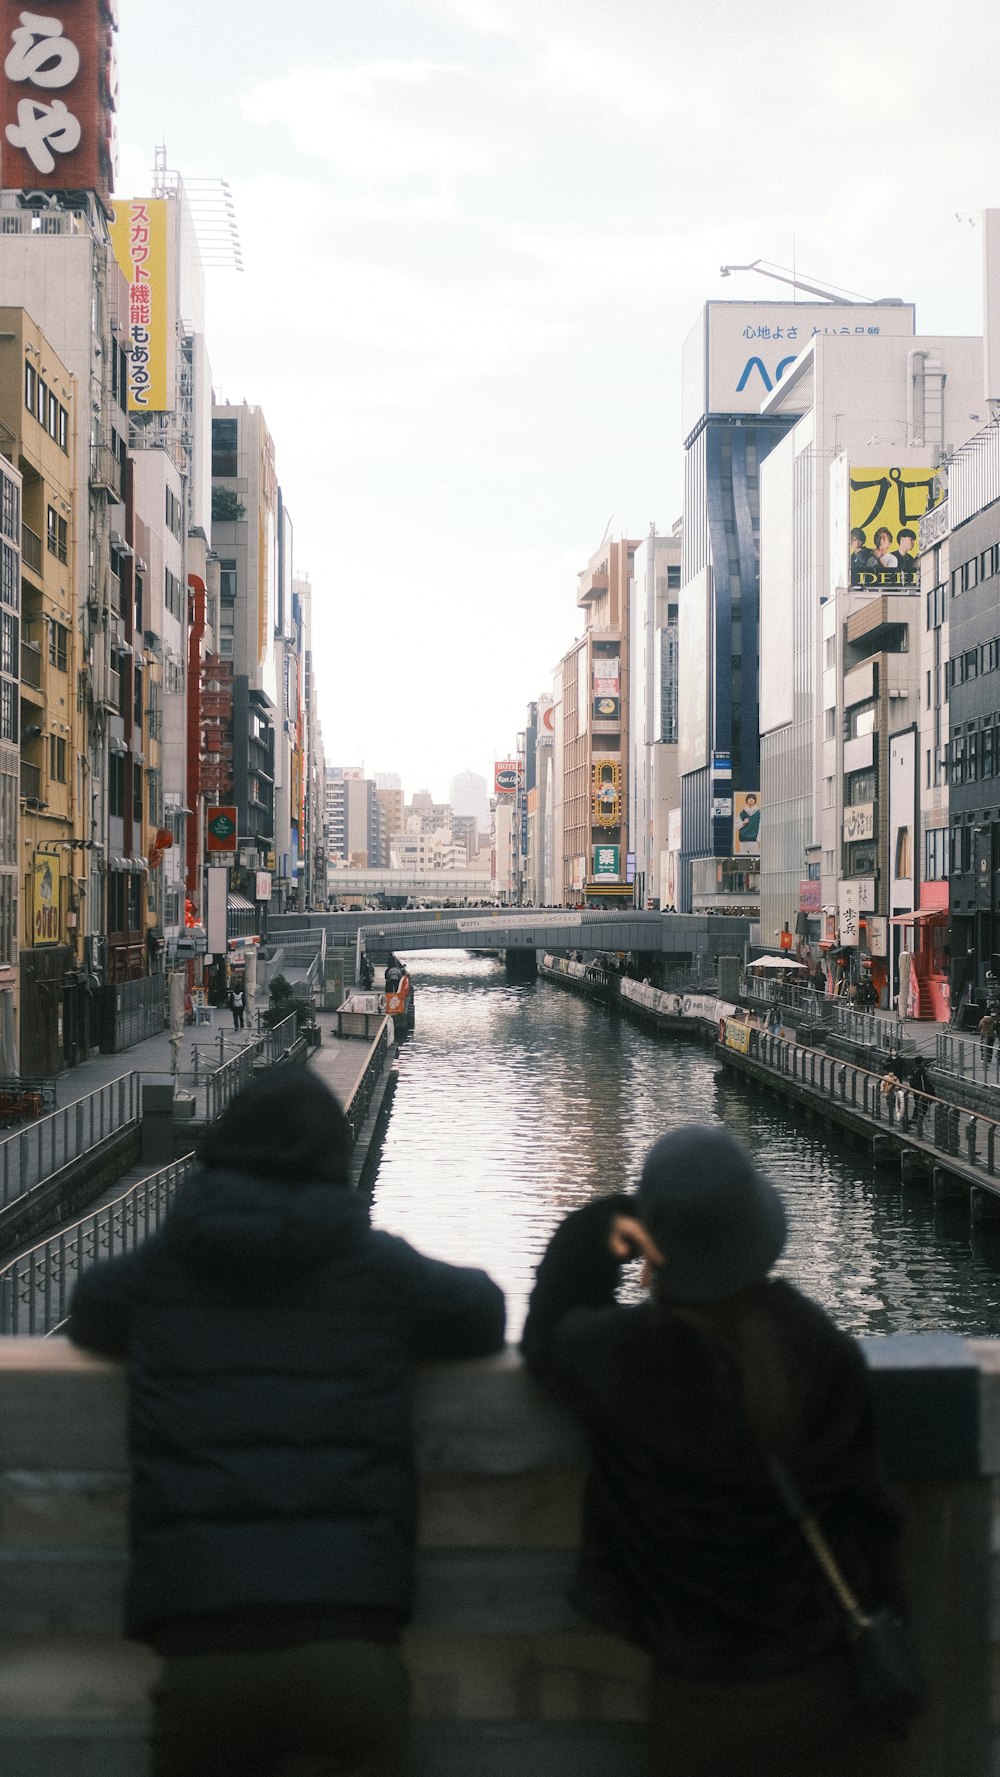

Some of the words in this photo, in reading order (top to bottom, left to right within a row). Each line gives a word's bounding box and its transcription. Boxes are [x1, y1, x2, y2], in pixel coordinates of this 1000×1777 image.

[130, 204, 150, 404] スカウト機能もあるで
[743, 325, 798, 339] 心地よさ
[842, 907, 858, 936] 歩兵
